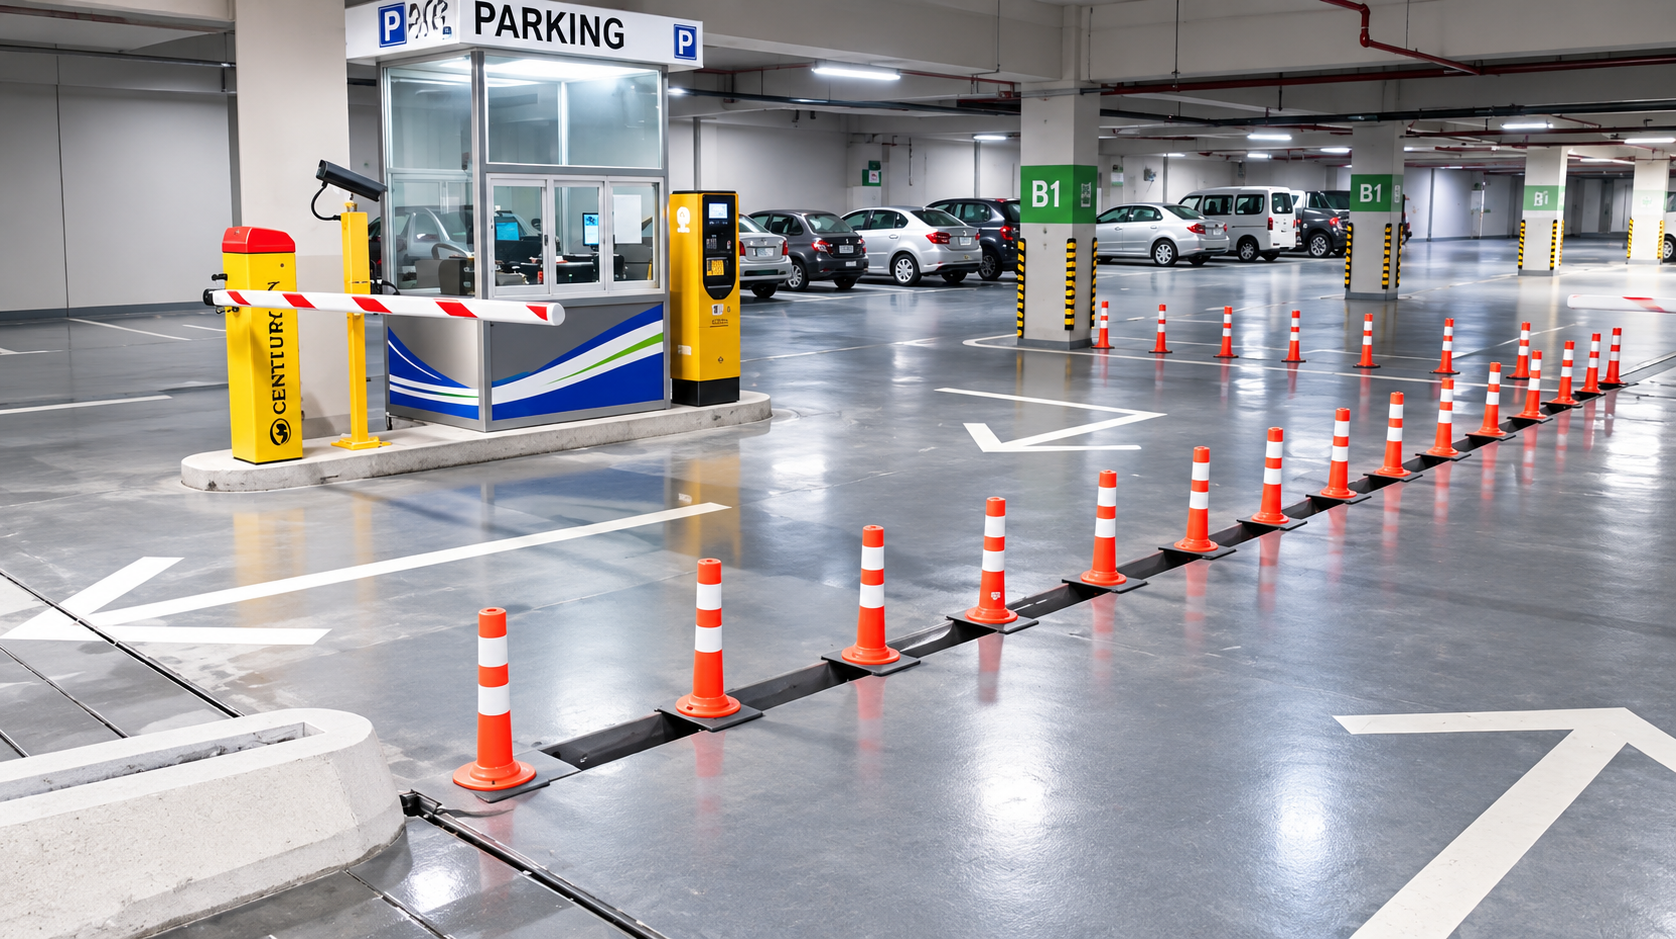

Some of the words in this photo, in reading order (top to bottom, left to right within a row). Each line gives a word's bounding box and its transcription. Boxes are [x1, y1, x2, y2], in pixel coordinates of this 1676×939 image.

[384, 10, 401, 42] P
[474, 0, 625, 50] PARKING
[678, 29, 693, 55] P
[1032, 180, 1060, 208] B1
[1359, 183, 1382, 203] B1
